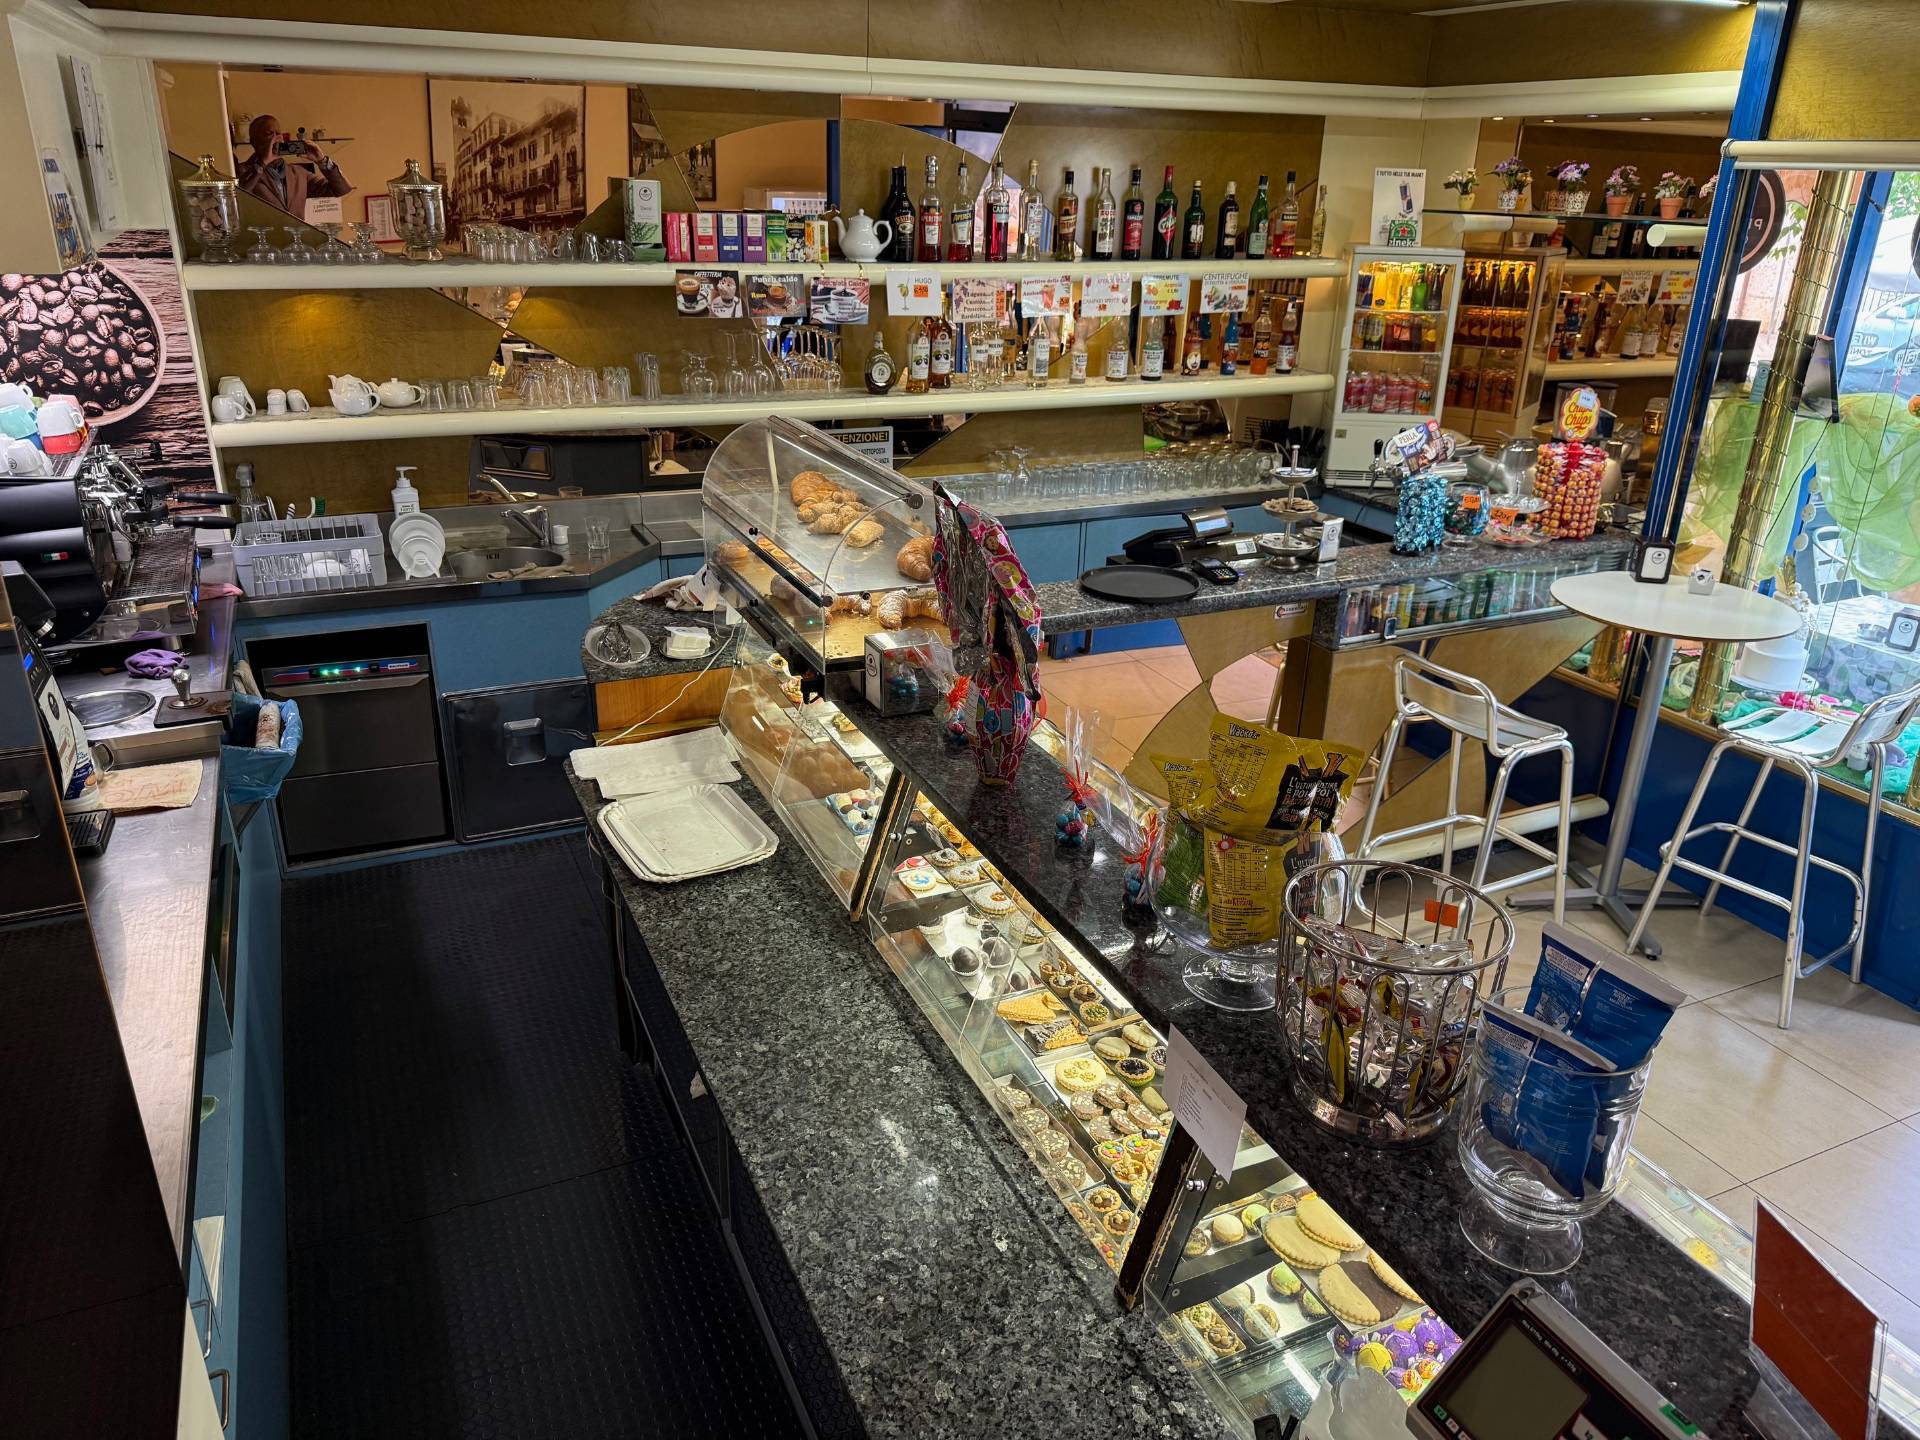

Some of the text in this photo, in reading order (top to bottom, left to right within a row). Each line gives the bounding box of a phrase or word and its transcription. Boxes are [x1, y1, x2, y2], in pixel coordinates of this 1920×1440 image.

[779, 275, 798, 283] caldo
[914, 277, 932, 285] HUGO
[1203, 272, 1248, 281] CENTRIFUGHE
[1565, 413, 1592, 426] Chups
[835, 431, 888, 443] TENZIONE!
